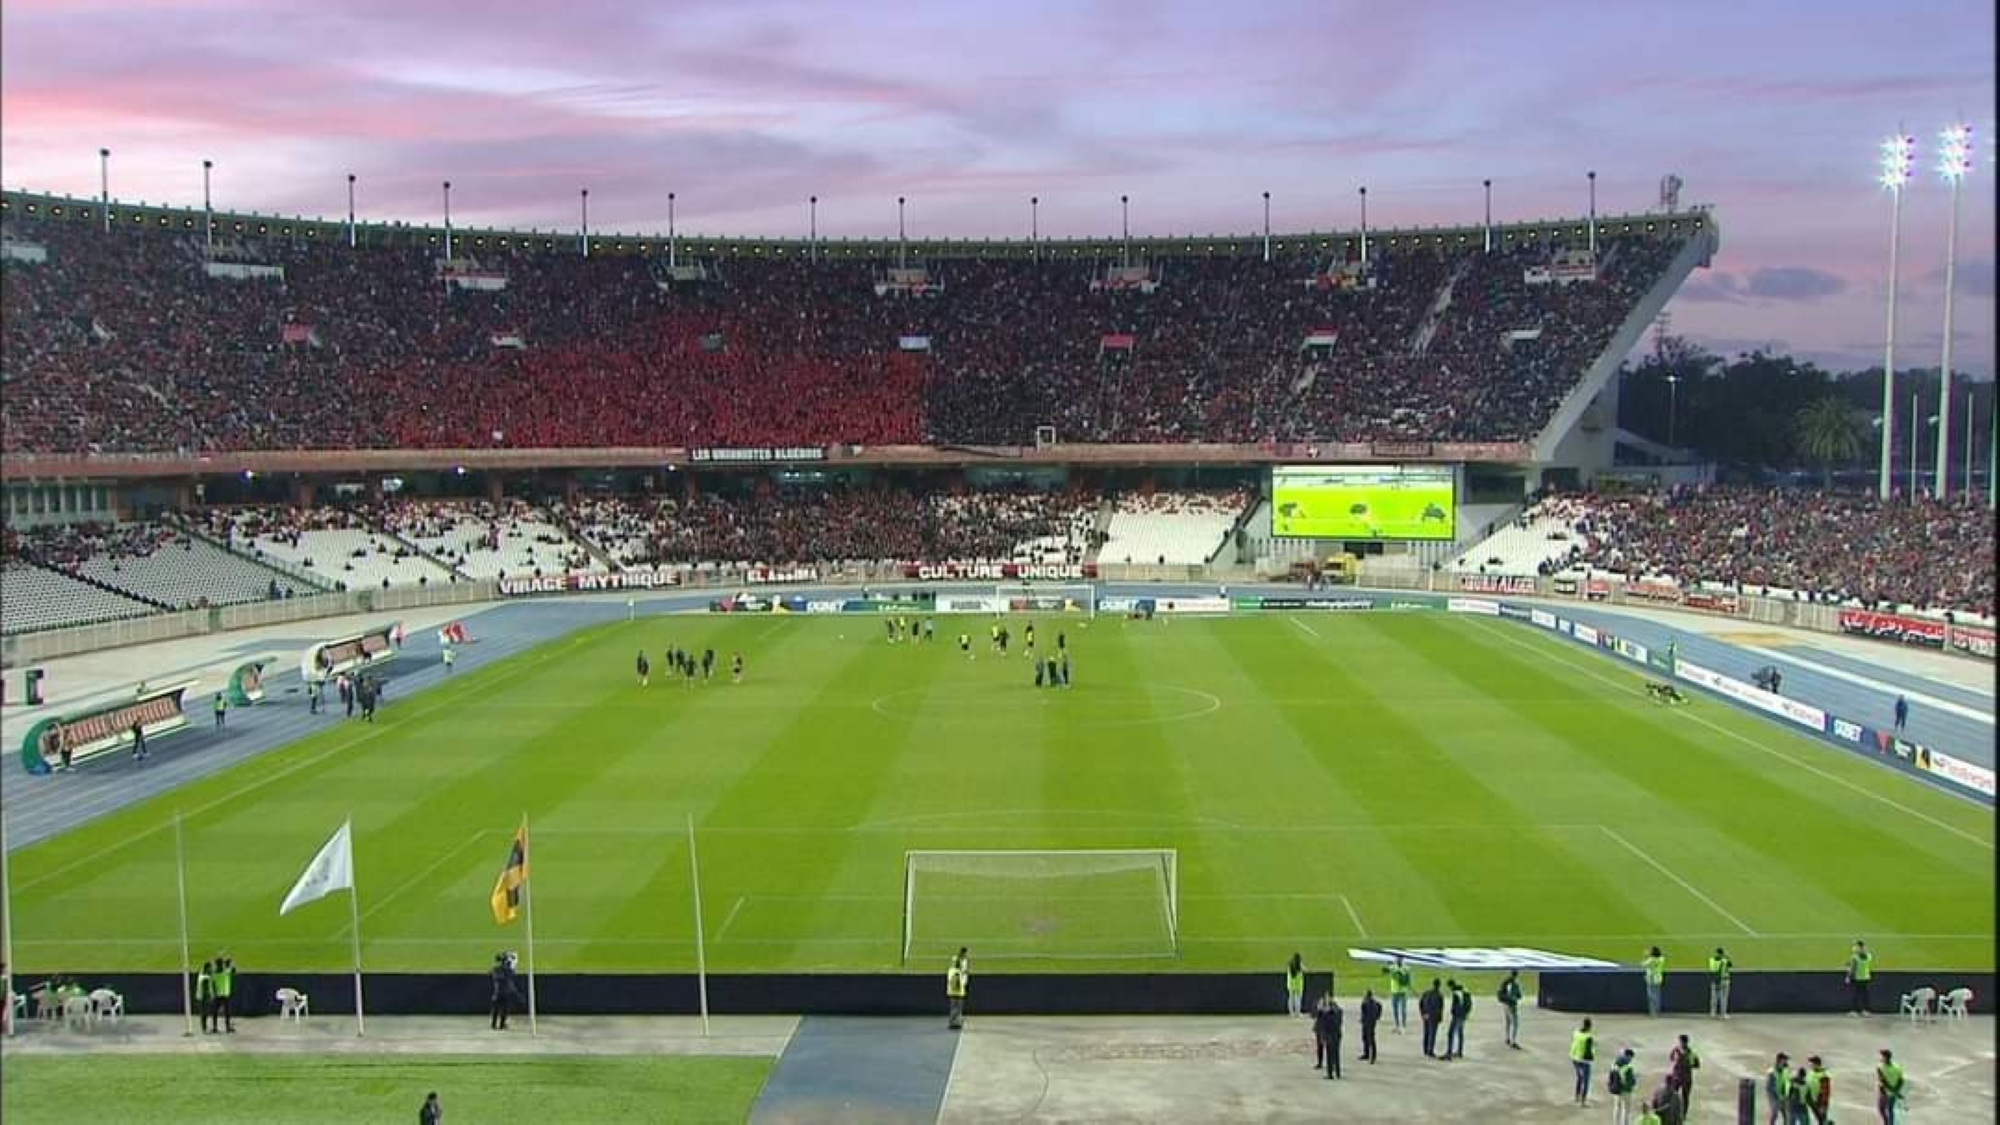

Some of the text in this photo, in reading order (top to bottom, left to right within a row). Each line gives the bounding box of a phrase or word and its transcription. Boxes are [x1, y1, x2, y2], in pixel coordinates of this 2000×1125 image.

[919, 563, 1083, 578] CULTURE UNIQUE
[500, 572, 678, 593] VIRAGE MYTHIQUE
